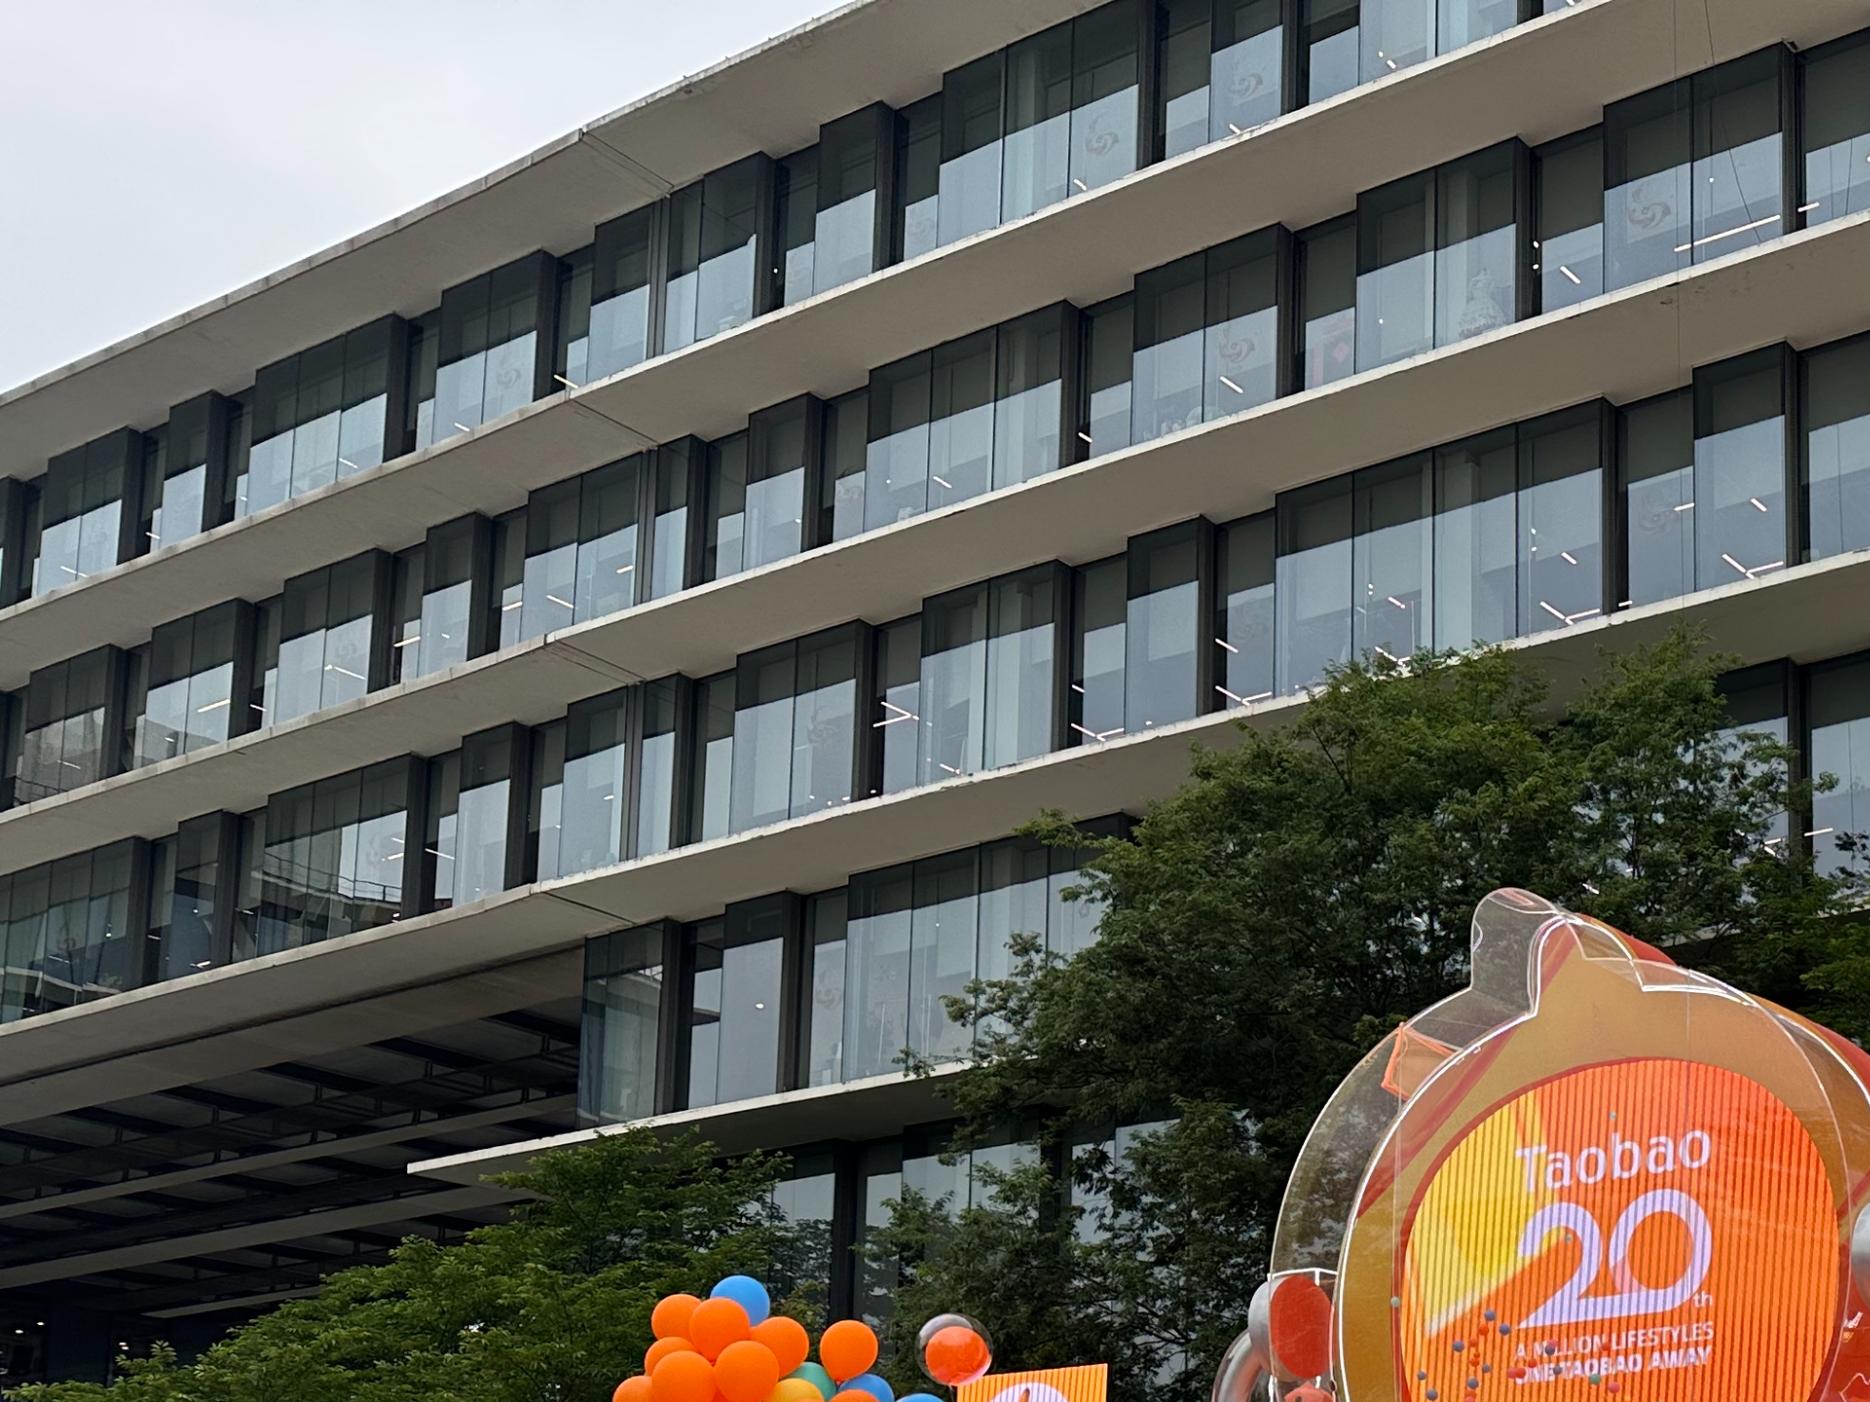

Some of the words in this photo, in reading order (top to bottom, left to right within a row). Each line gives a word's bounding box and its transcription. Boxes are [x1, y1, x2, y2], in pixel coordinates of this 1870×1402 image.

[1515, 1129, 1712, 1193] Taobao
[1517, 1188, 1713, 1330] 20
[1515, 1343, 1528, 1358] A
[1533, 1334, 1609, 1358] MLLION
[1611, 1321, 1714, 1351] LIFESTYLES
[1648, 1345, 1712, 1371] AWAY
